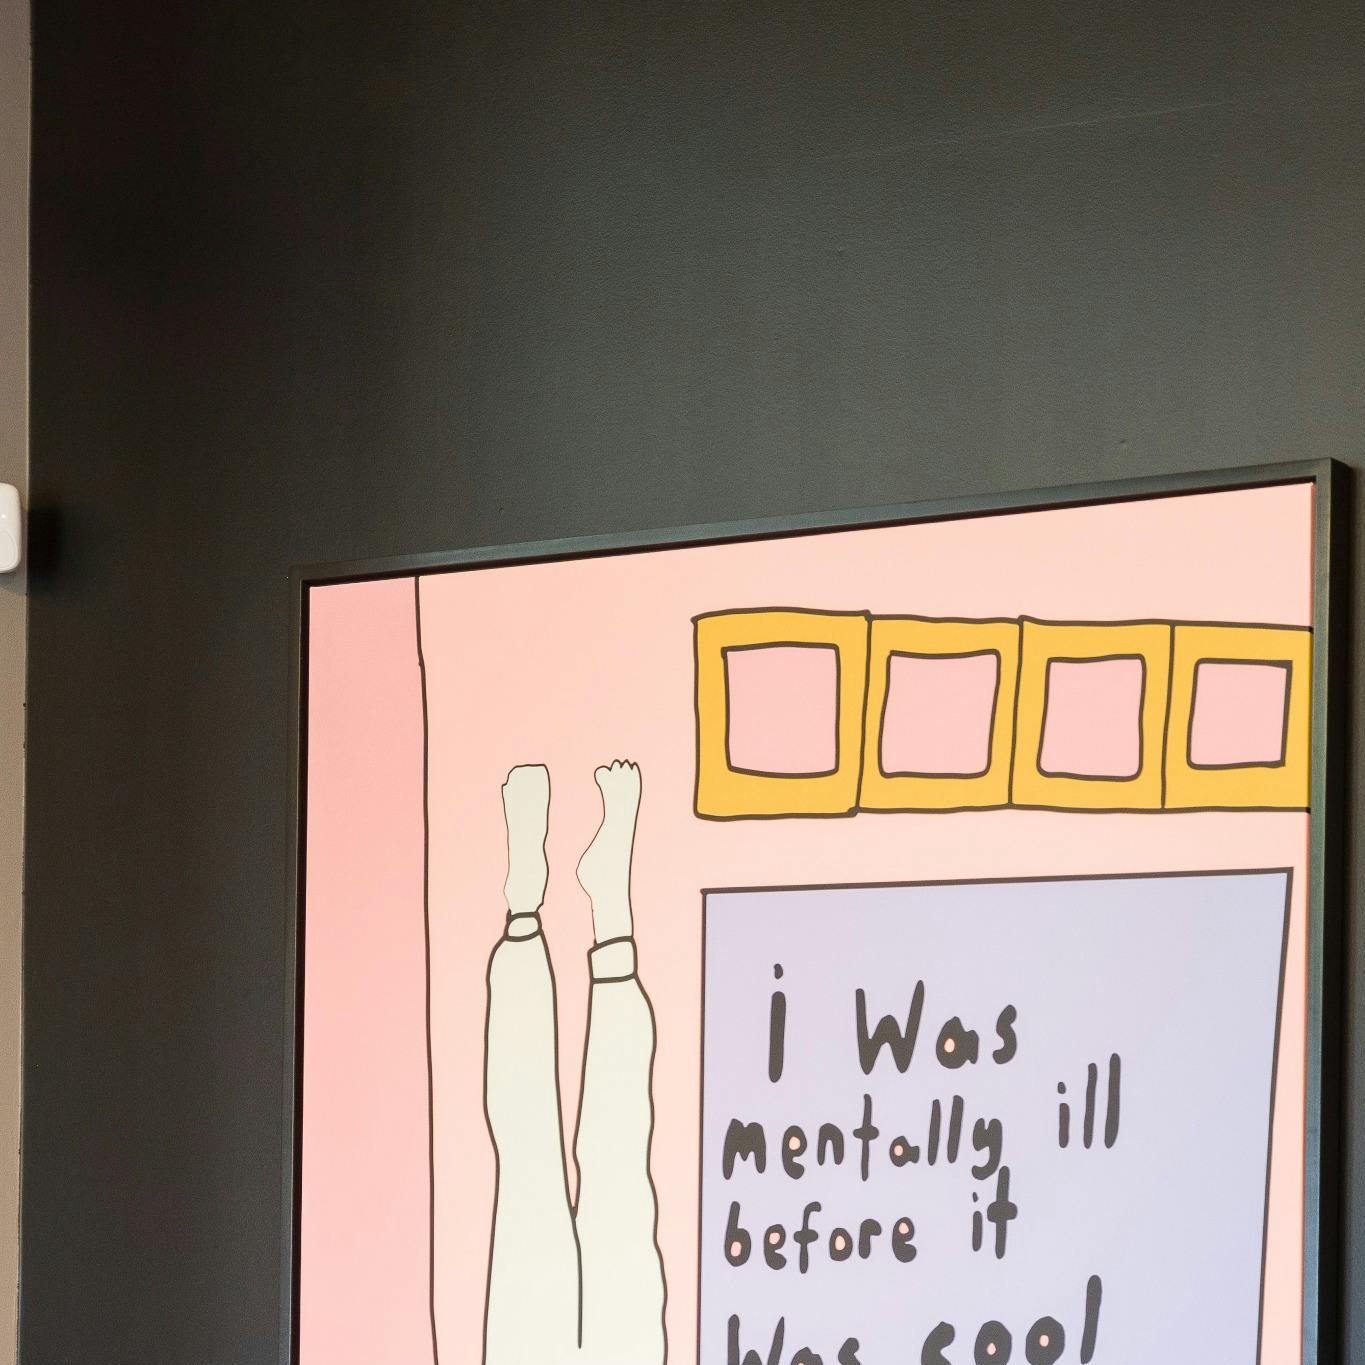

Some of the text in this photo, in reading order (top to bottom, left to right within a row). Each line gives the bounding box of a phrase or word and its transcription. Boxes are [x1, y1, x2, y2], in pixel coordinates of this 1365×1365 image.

[722, 1052, 1122, 1181] mentally ill
[723, 1164, 1018, 1275] before it
